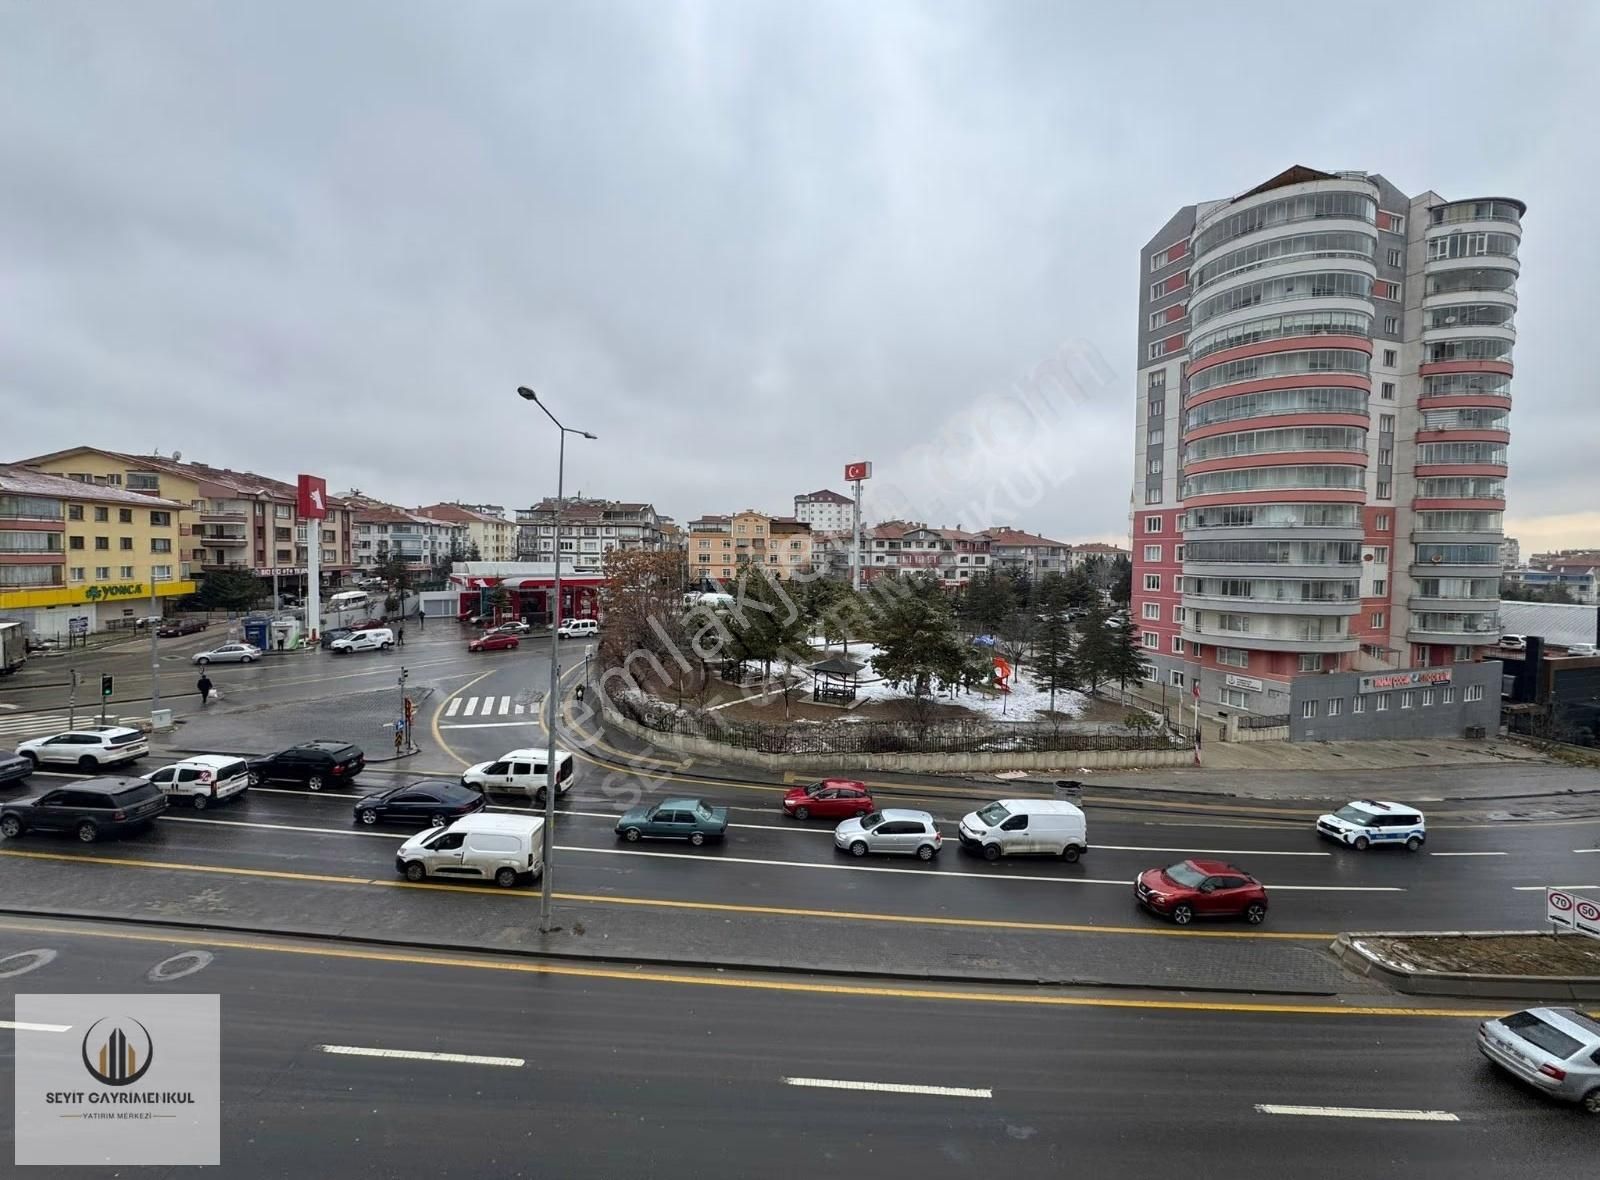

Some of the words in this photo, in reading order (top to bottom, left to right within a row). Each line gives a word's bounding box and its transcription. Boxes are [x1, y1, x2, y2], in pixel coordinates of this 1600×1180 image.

[101, 584, 143, 600] YONCA
[1555, 896, 1567, 908] 70
[1582, 906, 1595, 917] 50
